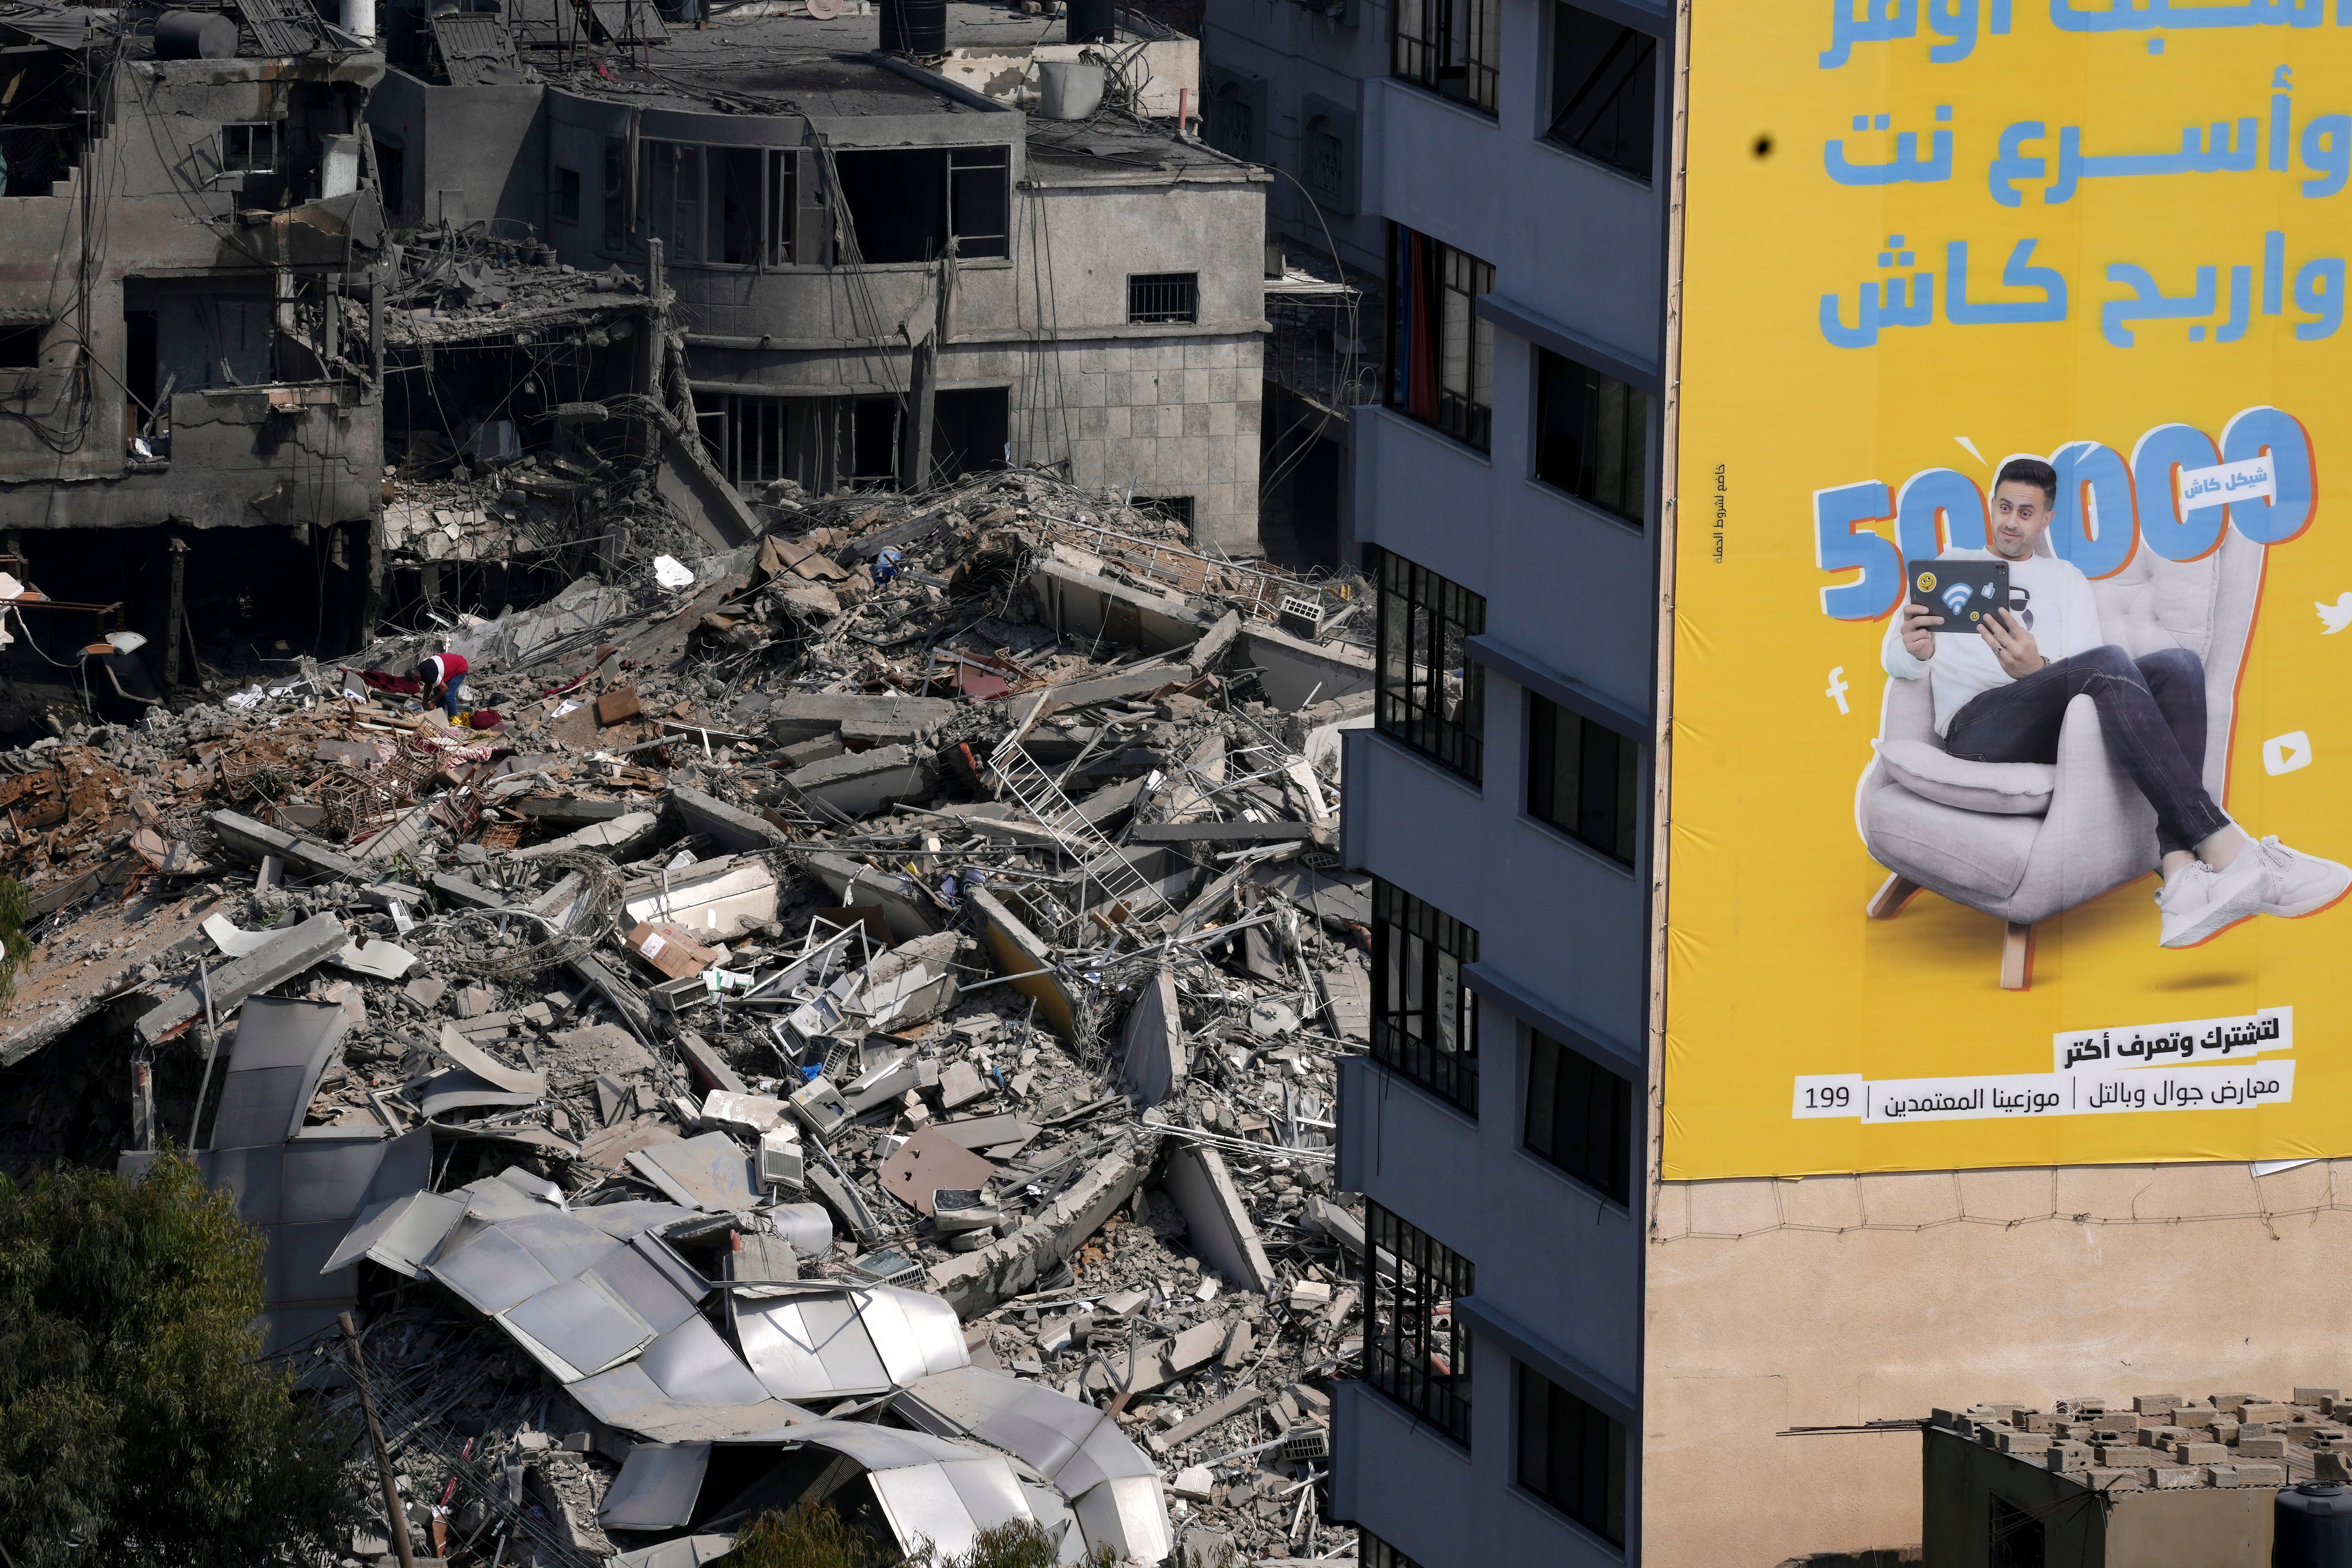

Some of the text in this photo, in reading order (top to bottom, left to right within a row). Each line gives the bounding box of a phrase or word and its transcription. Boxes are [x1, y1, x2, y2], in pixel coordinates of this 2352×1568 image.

[1825, 65, 2352, 207] وأسرع نت
[1820, 231, 2345, 349] واربح كاش
[2184, 467, 2268, 499] شيكل كاش
[1713, 464, 1727, 564] خاضع لشروط الحملة
[2117, 1032, 2193, 1061] وتعرف
[2201, 1018, 2280, 1054] لتشترك
[1805, 1077, 2280, 1116] معارض جوال وبالتل موزعينا المعتمدين 199
